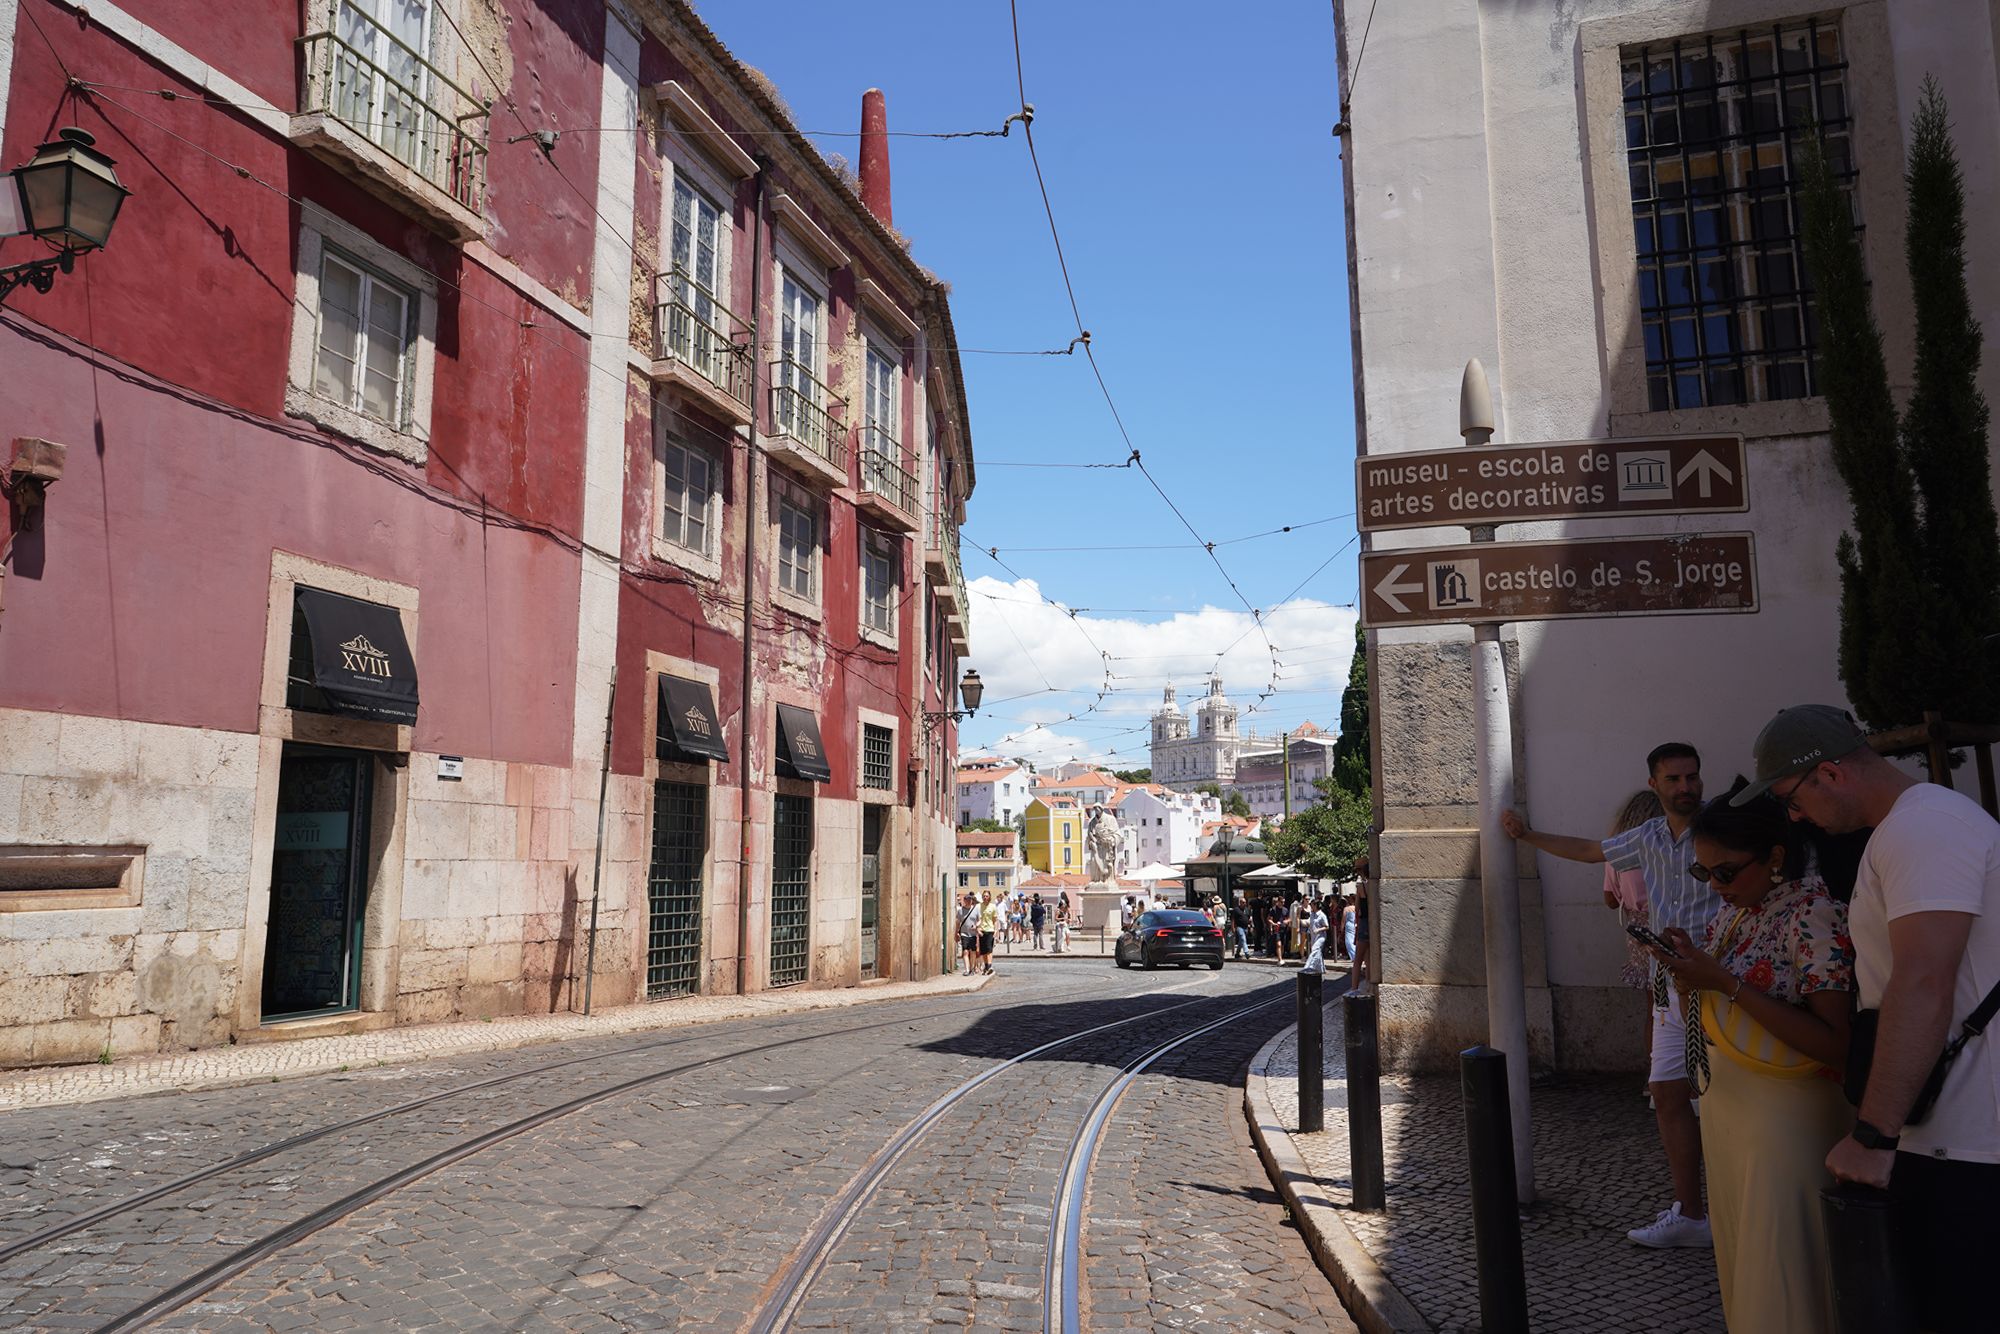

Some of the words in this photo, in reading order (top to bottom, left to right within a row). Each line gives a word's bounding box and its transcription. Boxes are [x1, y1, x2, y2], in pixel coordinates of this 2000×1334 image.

[1368, 462, 1449, 487] museu
[1478, 449, 1565, 478] escola
[1578, 448, 1611, 473] de
[1370, 491, 1435, 517] artes
[1448, 481, 1605, 511] decorativas
[1484, 563, 1577, 591] castelo
[1591, 562, 1622, 587] de
[1636, 559, 1661, 585] S.
[1673, 559, 1743, 588] Jorge
[341, 651, 392, 677] XVIII
[687, 718, 711, 735] XVIII
[796, 742, 817, 756] XVIII
[285, 828, 321, 843] XVIII
